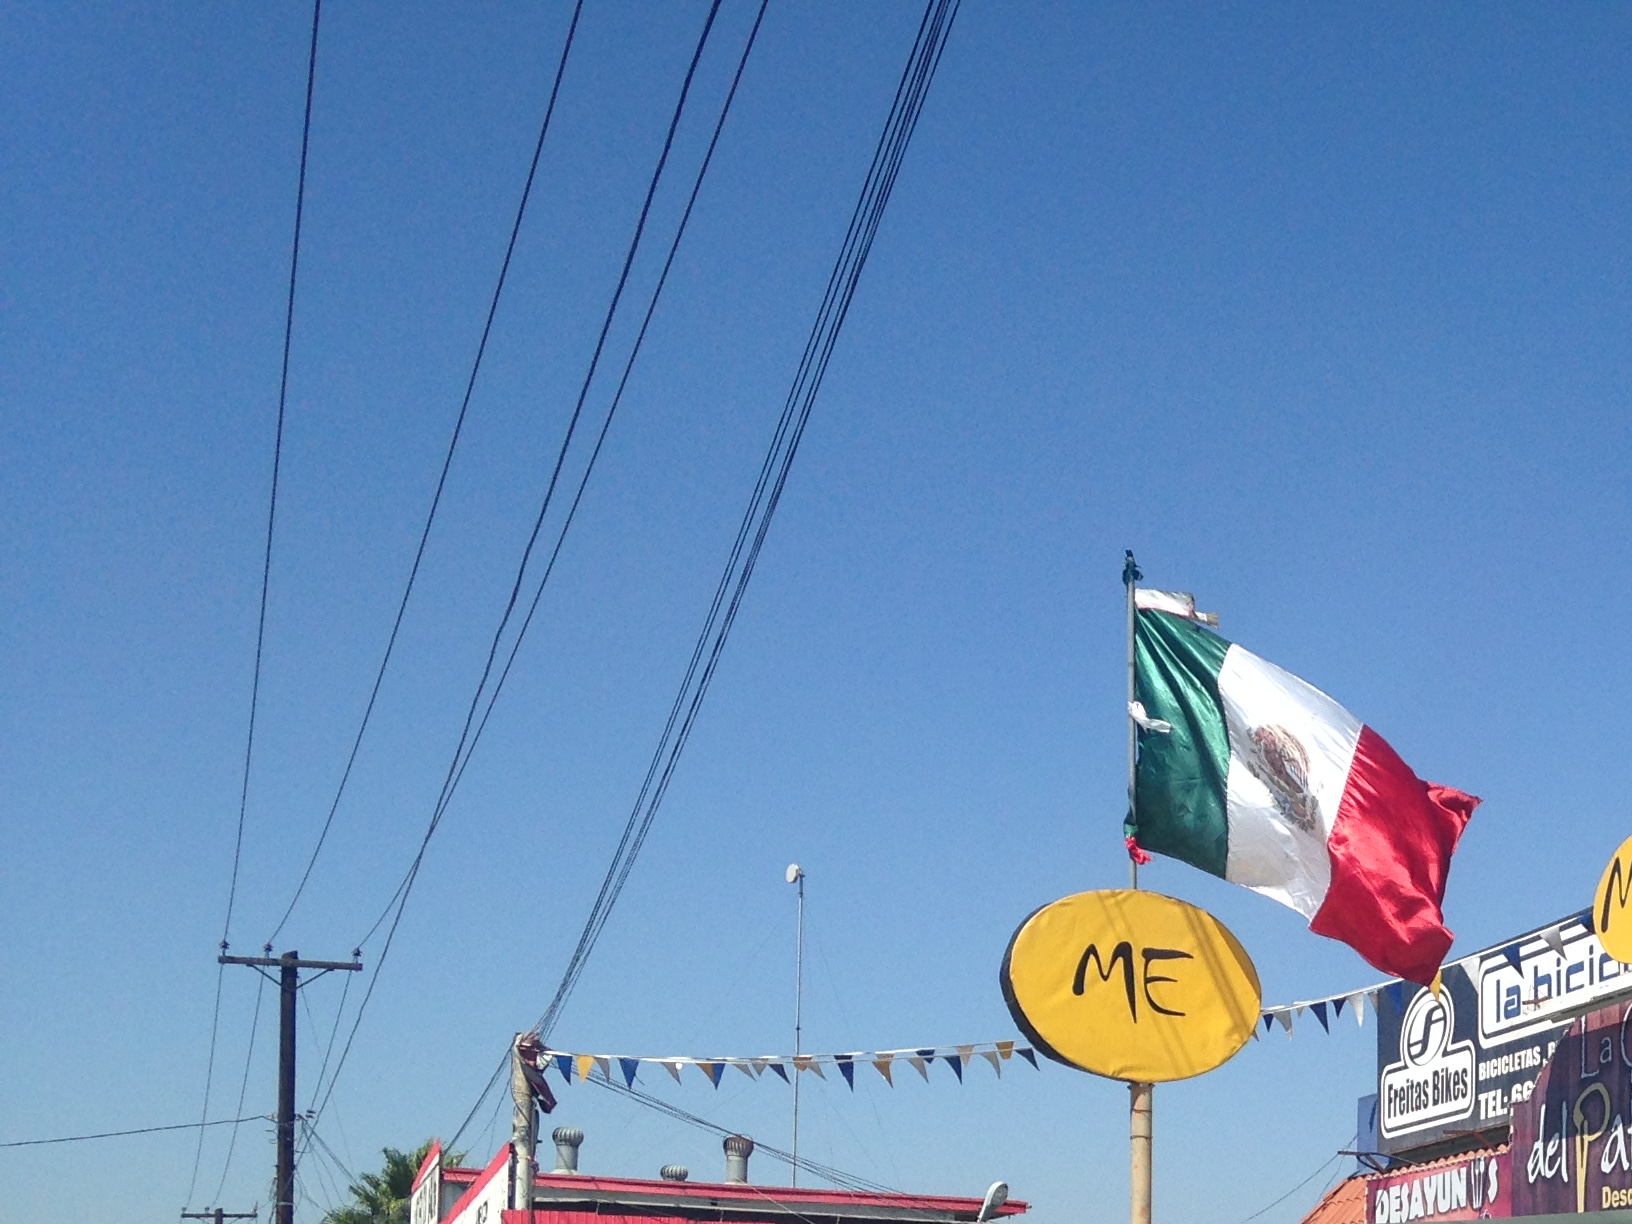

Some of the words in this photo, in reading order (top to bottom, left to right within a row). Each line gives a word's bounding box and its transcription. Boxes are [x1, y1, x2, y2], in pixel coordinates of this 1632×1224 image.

[1072, 941, 1194, 1024] ME
[1495, 970, 1521, 1023] la
[1478, 1047, 1542, 1082] BICICLETAS
[1581, 1015, 1612, 1079] La
[1387, 1076, 1430, 1120] Freitas
[1432, 1067, 1468, 1107] Bikes
[1479, 1088, 1508, 1121] TEL:
[1527, 1101, 1568, 1184] del
